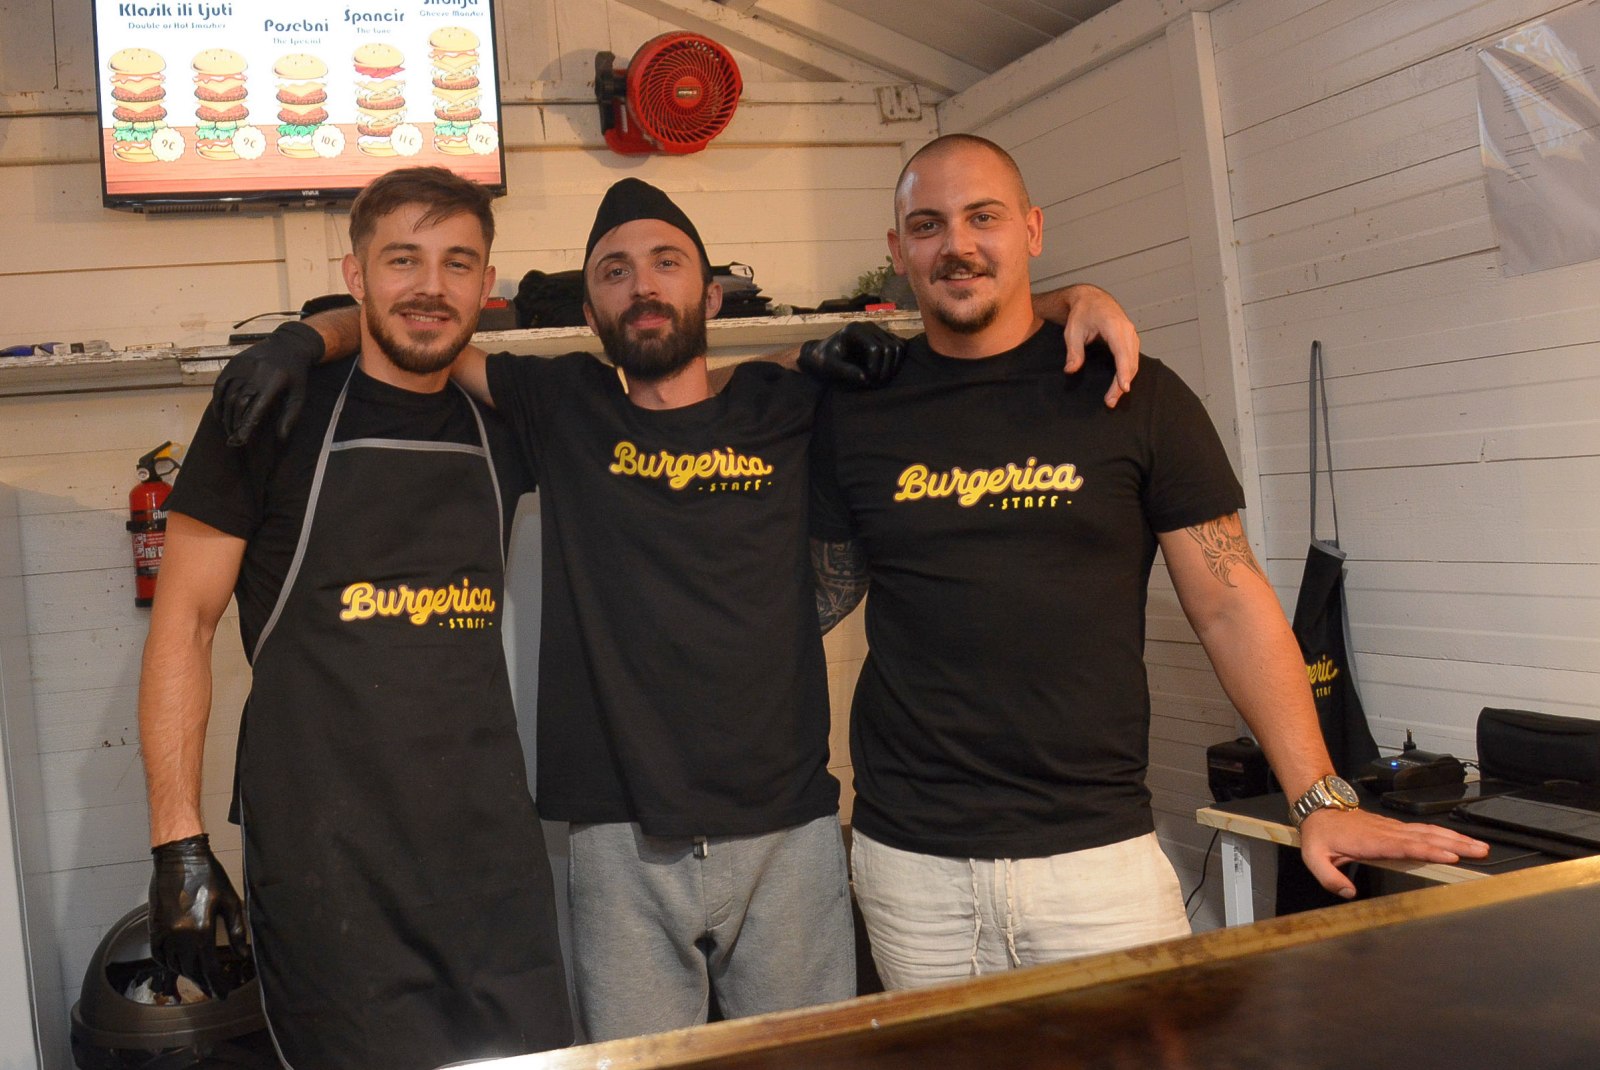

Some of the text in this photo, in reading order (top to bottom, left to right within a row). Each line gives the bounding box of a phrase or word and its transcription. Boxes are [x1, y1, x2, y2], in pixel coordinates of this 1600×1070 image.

[119, 3, 172, 16] Klasik
[177, 3, 192, 16] ili
[264, 18, 329, 32] Posebni
[609, 441, 774, 491] Burgerica
[893, 456, 1084, 508] Burgerica
[340, 577, 496, 626] Burgerica
